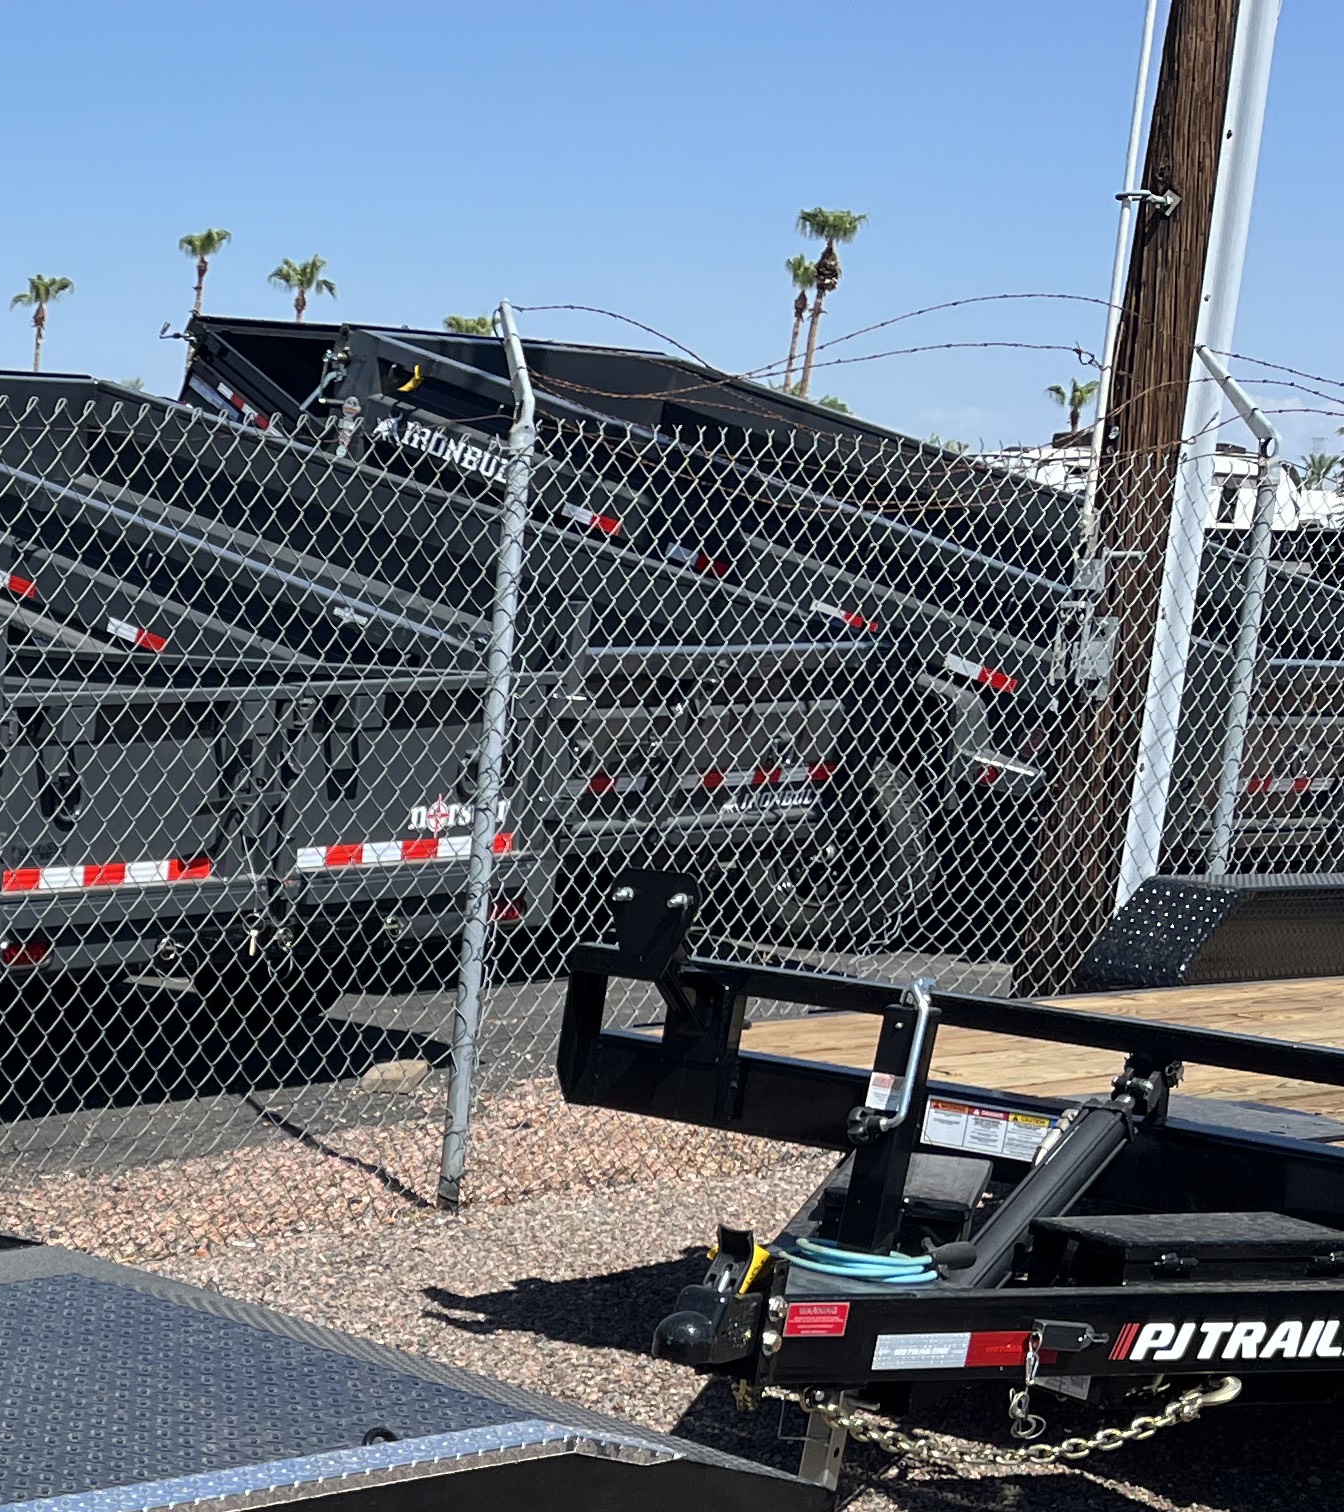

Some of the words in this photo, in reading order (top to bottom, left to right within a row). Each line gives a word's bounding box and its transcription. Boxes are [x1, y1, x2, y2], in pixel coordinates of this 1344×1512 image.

[400, 421, 508, 484] IRONBUL
[407, 794, 512, 838] norsr
[1129, 1322, 1196, 1361] PJ
[1196, 1320, 1344, 1360] TRAIL
